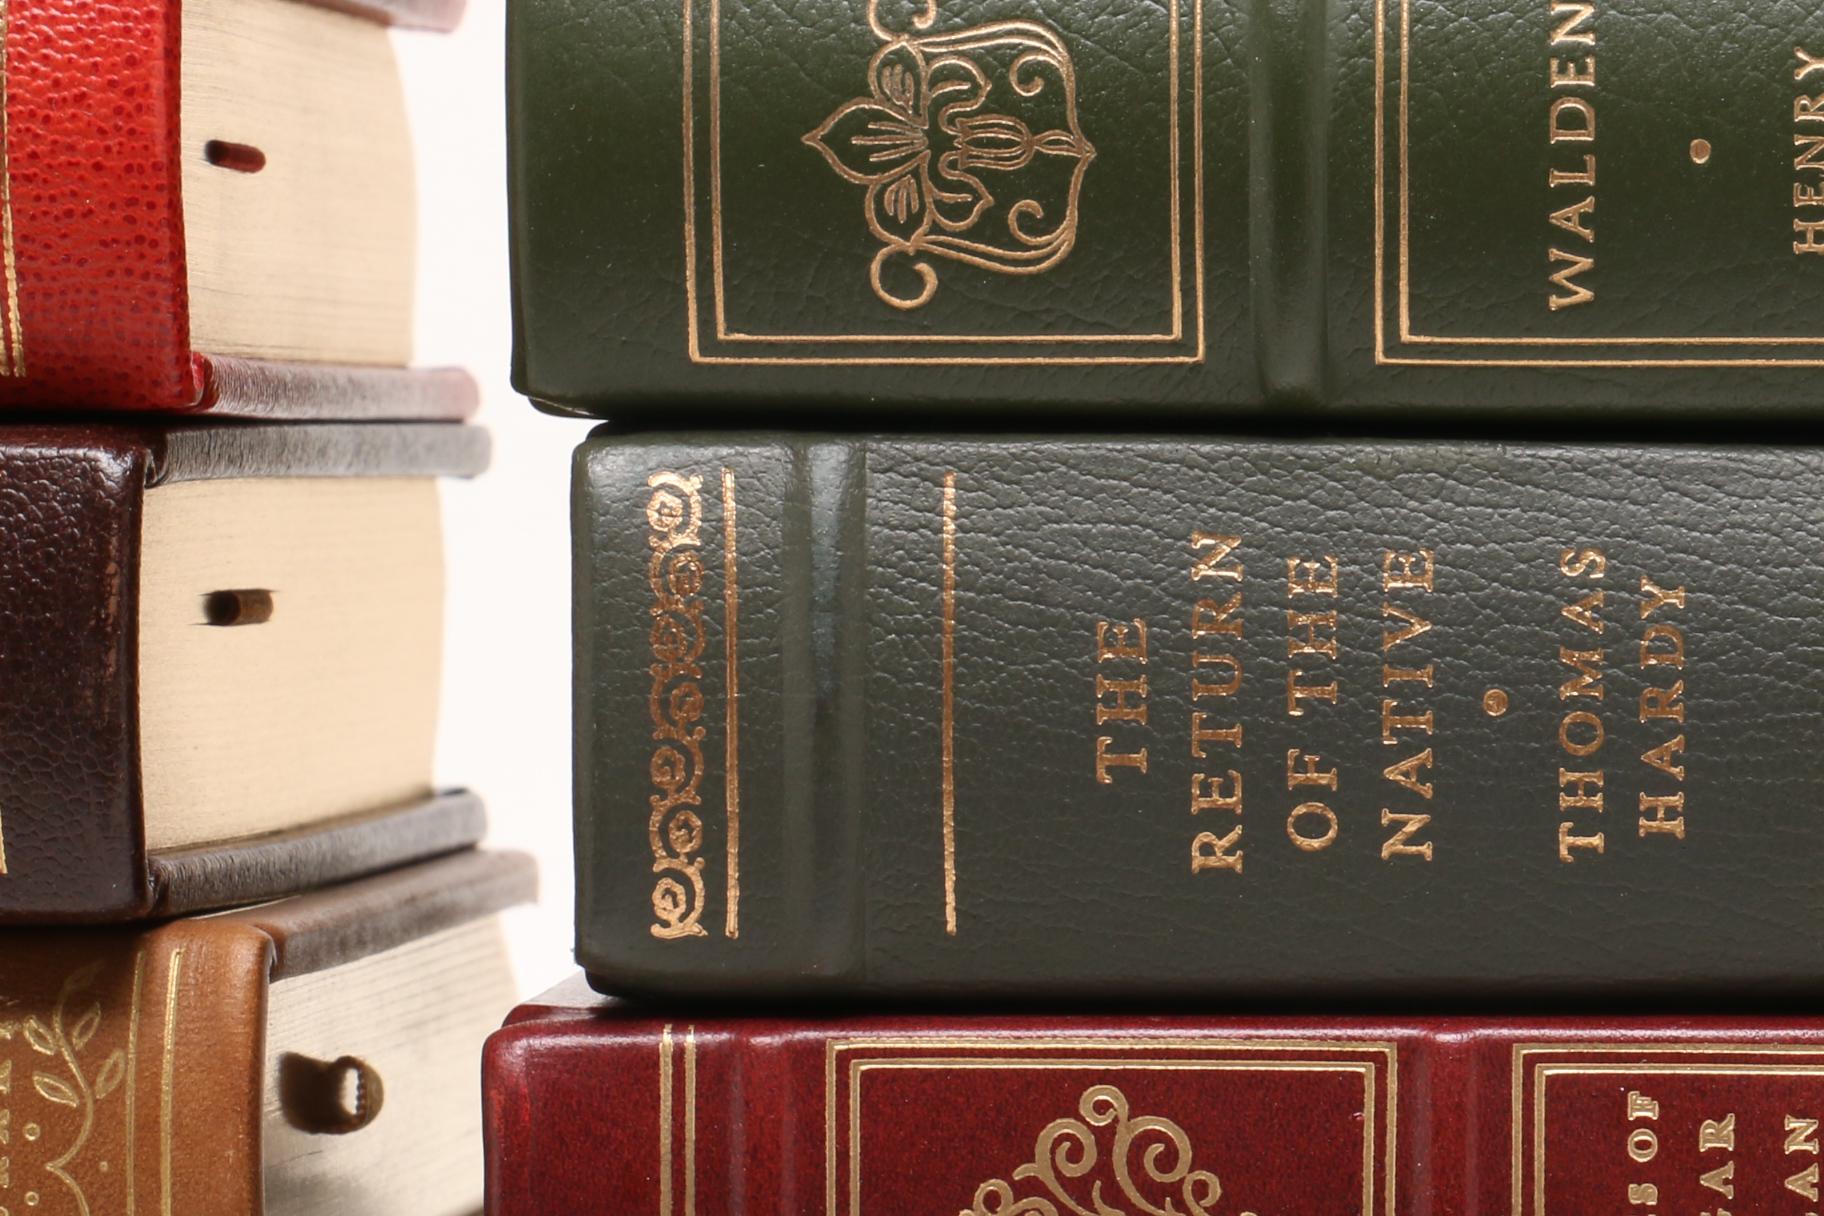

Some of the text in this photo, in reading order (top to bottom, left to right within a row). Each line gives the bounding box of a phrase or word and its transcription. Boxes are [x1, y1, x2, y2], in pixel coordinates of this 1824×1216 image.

[1549, 1, 1596, 311] WALDEN
[1096, 618, 1148, 784] THE
[1191, 530, 1243, 874] RETURN
[1287, 554, 1338, 853] OF THE
[1381, 547, 1434, 862] NATIVE
[1558, 546, 1606, 863] THOMAS
[1639, 575, 1686, 840] HARDY
[1627, 1090, 1660, 1163] OF
